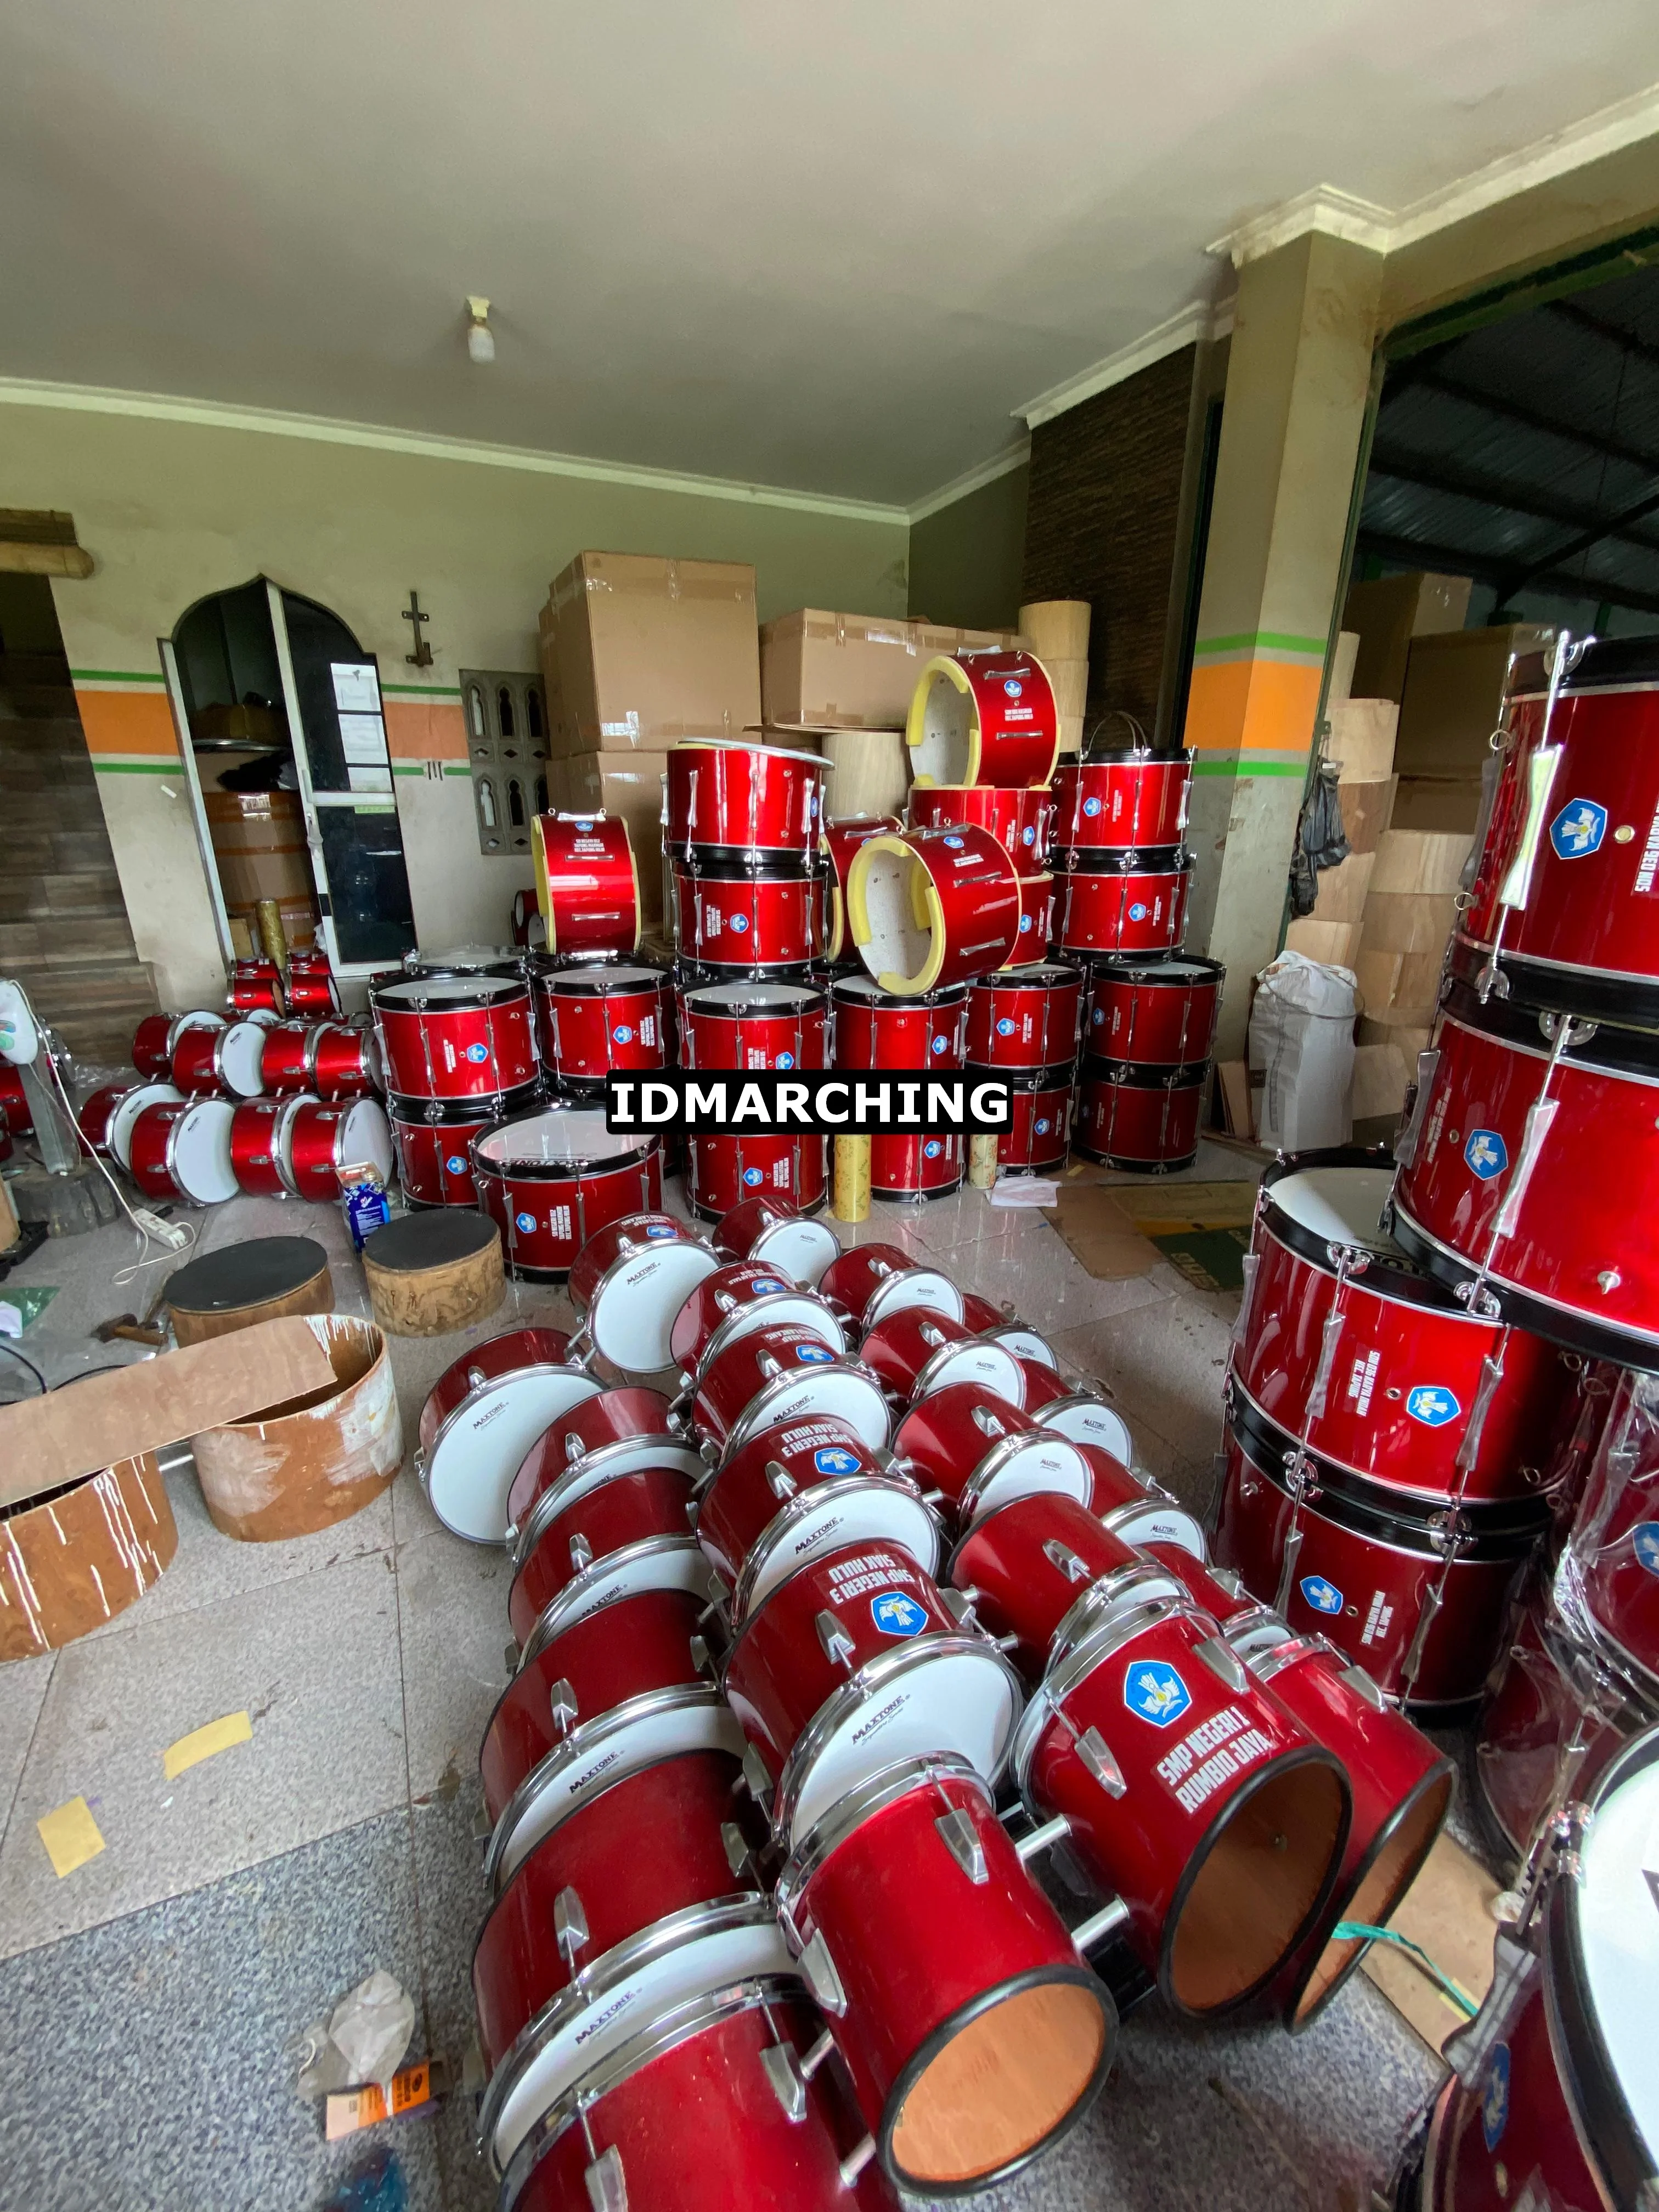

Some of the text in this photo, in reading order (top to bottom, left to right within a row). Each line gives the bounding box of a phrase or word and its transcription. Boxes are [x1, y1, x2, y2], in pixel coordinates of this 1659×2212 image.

[1640, 850, 1659, 871] 036
[1634, 871, 1655, 892] SDN
[627, 1262, 658, 1285] MAXTONE
[1348, 1373, 1362, 1398] TAPUNG
[1356, 1350, 1380, 1417] SDN 036 KARYA INDAH
[473, 1402, 505, 1429] MAXTONE
[773, 1395, 810, 1423] MAXTONE
[781, 1424, 838, 1443] SIAK HULU
[781, 1433, 853, 1457] SMP NEGERI 3
[795, 1517, 839, 1555] MAXTONE
[828, 1554, 896, 1583] SIAK HULU
[830, 1569, 915, 1604] SMP NEGERI 3
[852, 1695, 905, 1745] MAXTONE
[1156, 1706, 1251, 1786] SMP NEGERI 1
[569, 1751, 619, 1793] MAXTONE
[1175, 1729, 1273, 1814] RUMBIO JAYA
[575, 1990, 635, 2045] MAXTONE
